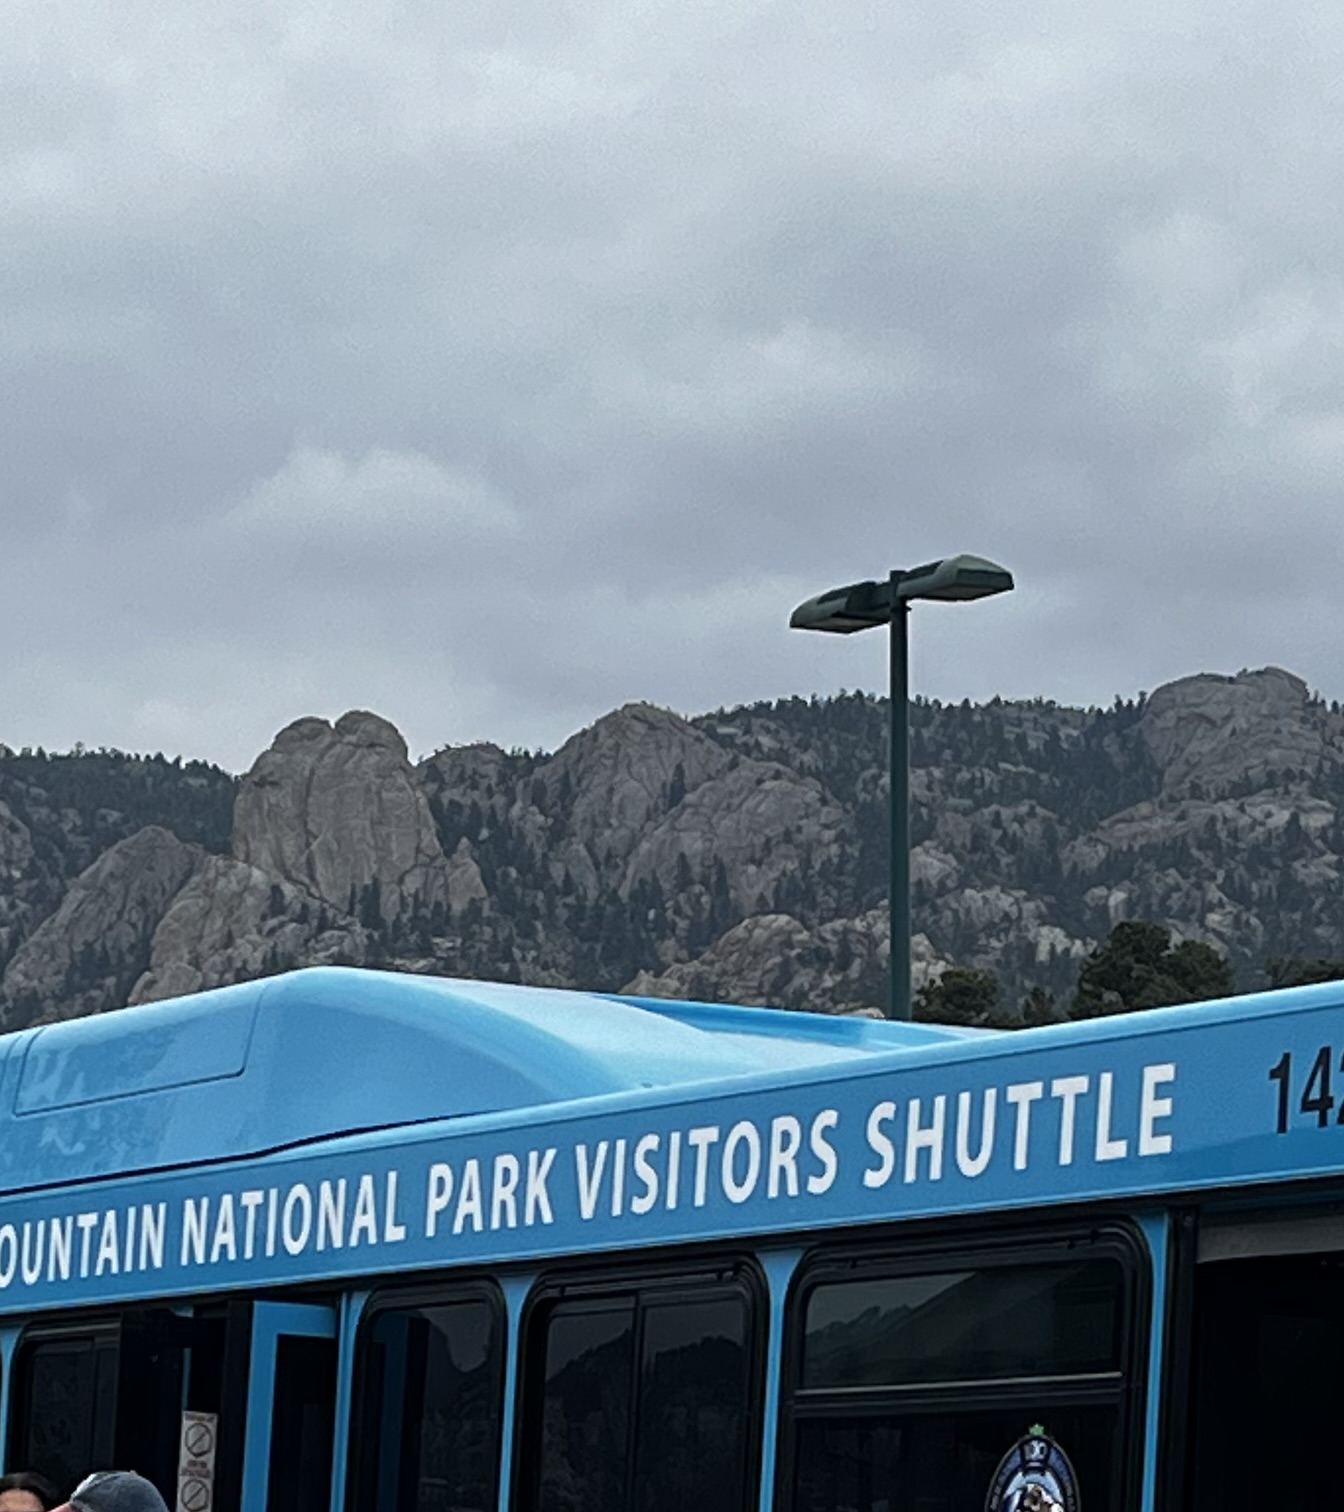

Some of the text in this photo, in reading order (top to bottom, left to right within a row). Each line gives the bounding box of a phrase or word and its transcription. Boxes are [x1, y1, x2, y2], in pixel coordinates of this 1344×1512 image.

[181, 1171, 406, 1267] NATIONAL
[426, 1148, 557, 1238] PARK
[576, 1109, 839, 1220] VISITORS
[863, 1062, 1176, 1189] SHUTTLE
